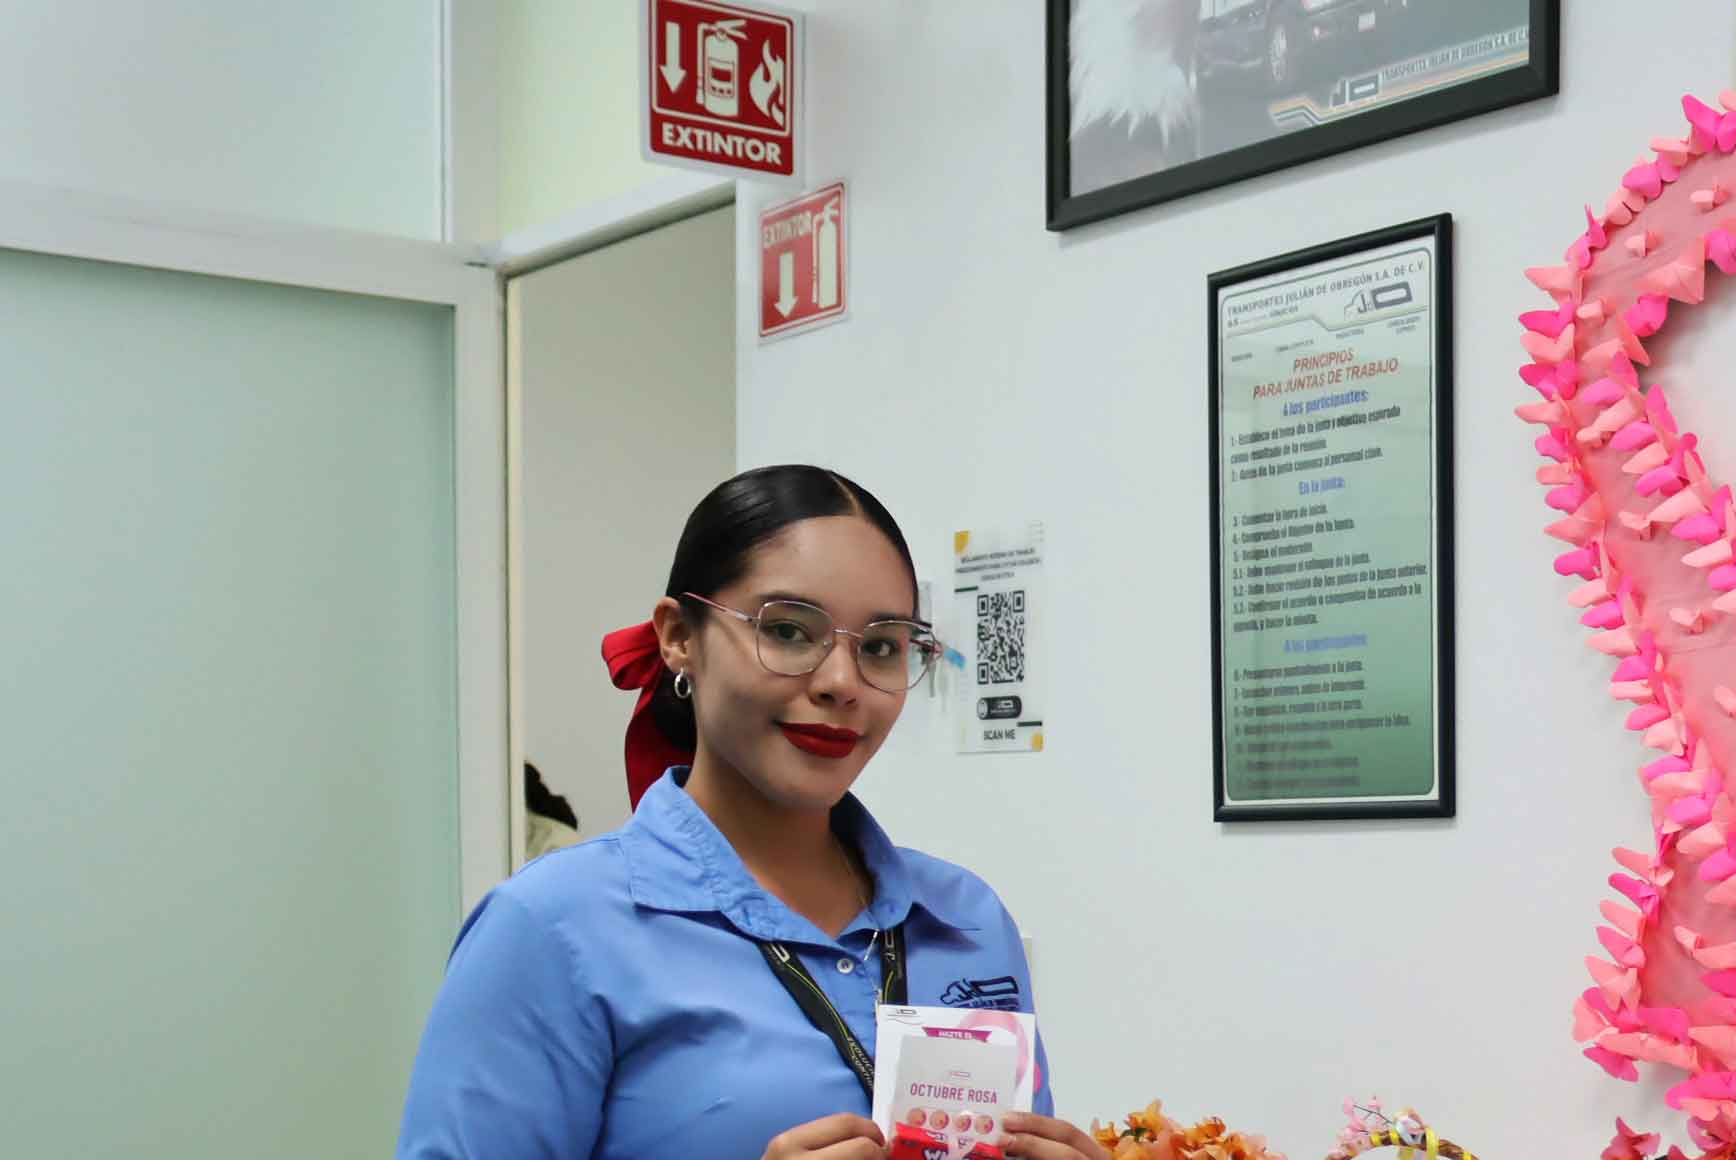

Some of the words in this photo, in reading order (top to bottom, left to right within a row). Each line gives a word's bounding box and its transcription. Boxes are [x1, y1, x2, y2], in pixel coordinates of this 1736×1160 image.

[662, 122, 781, 165] EXTINTOR
[1315, 284, 1326, 295] DE
[1293, 349, 1354, 371] PRINCIPIOS
[1253, 382, 1281, 398] PARA
[1284, 373, 1324, 392] JUNTAS
[1327, 368, 1343, 383] DE
[1345, 359, 1398, 378] TRABAJO
[983, 730, 1003, 741] SCAN
[1005, 728, 1016, 740] ME
[910, 1082, 964, 1101] OCTUBRE
[967, 1090, 998, 1105] ROSA
